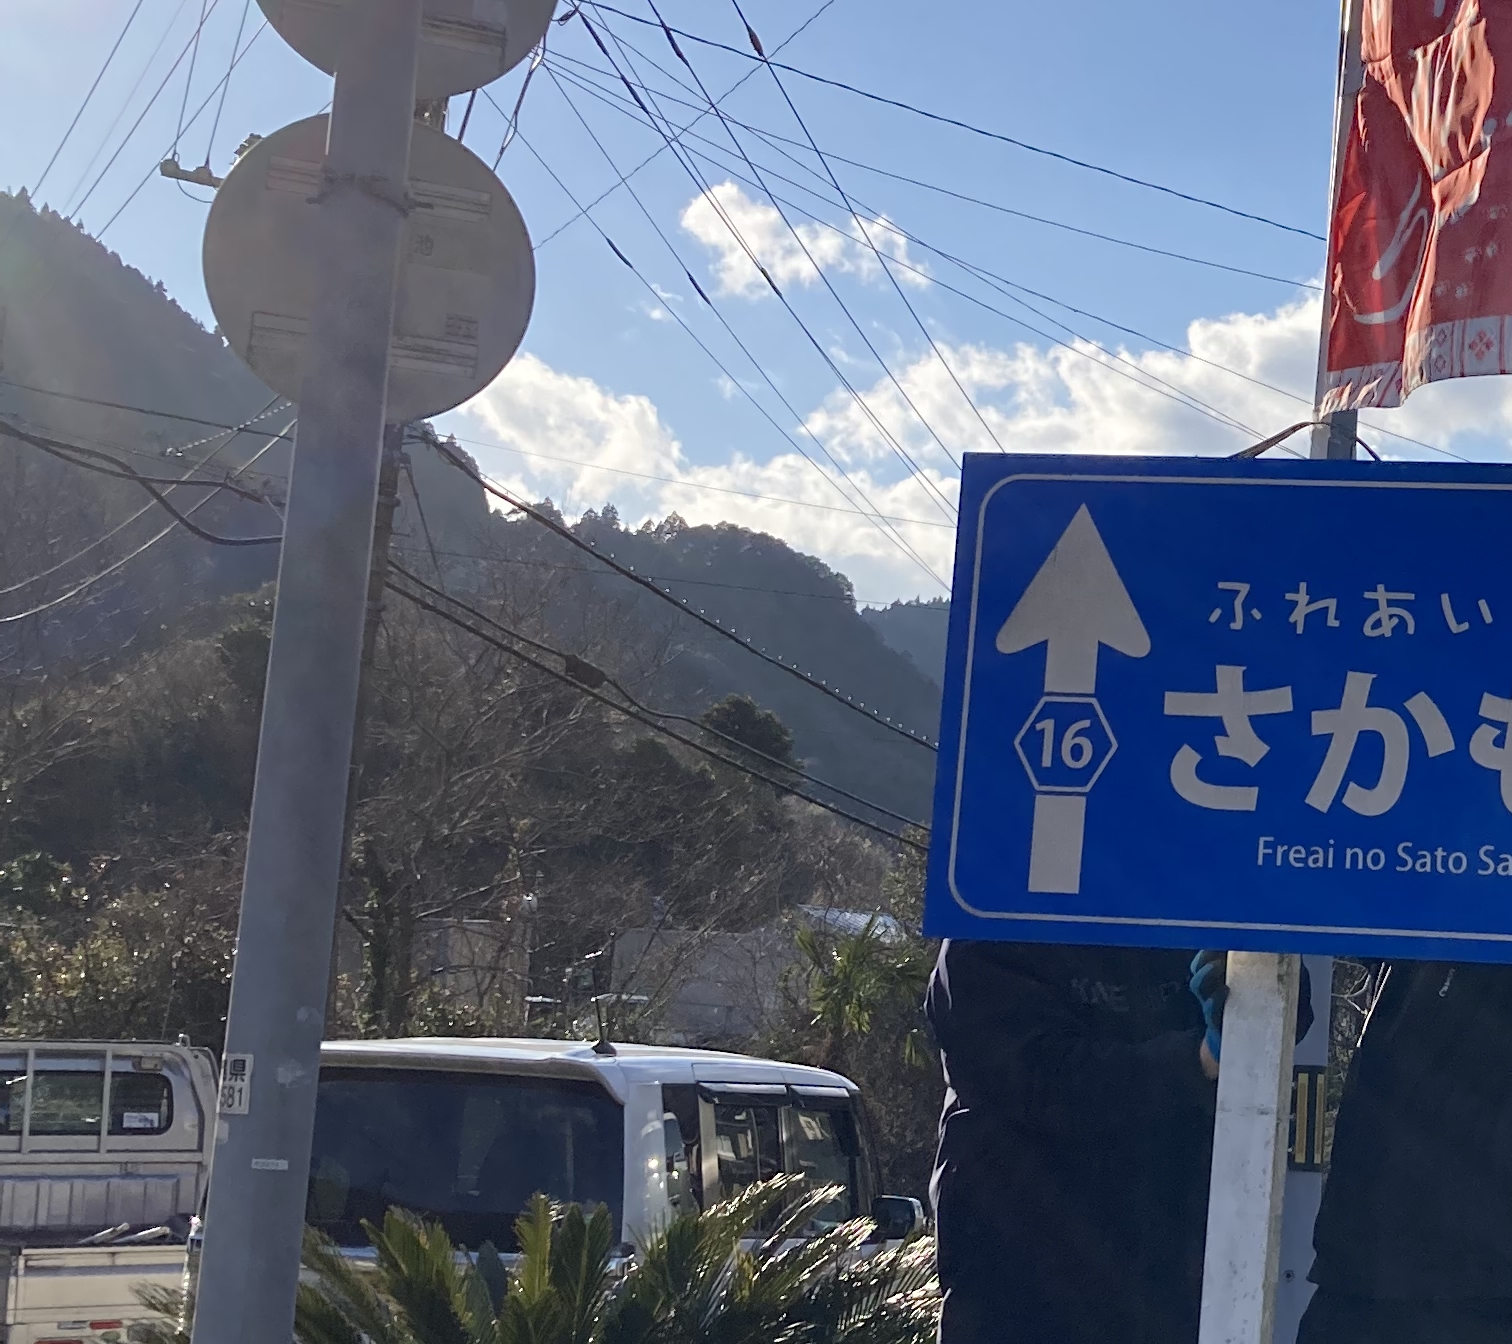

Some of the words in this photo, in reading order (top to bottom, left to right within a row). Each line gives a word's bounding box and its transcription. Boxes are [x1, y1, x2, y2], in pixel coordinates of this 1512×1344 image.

[1034, 718, 1094, 769] 16
[1256, 836, 1335, 868] Freai
[1344, 847, 1386, 871] no
[1395, 841, 1468, 875] Sato
